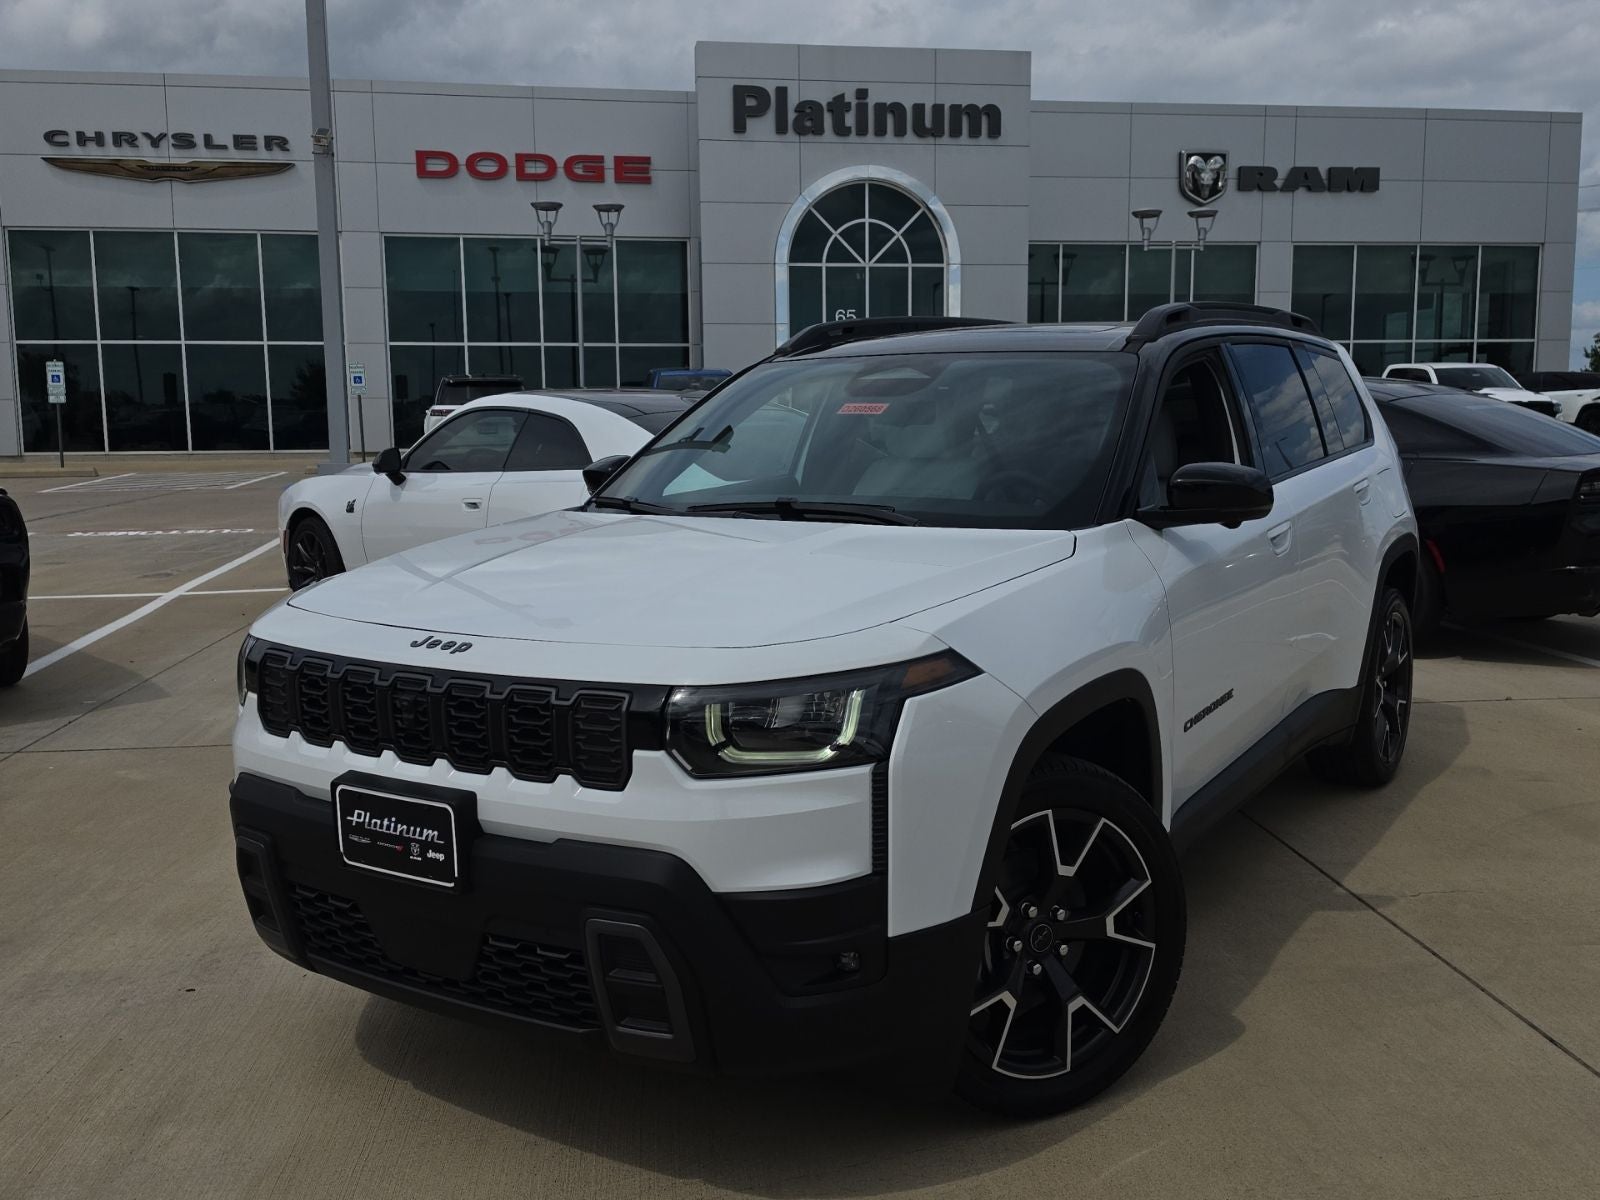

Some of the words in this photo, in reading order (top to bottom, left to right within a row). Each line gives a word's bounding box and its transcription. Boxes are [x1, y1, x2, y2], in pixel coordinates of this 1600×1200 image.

[733, 84, 1002, 138] Platinum
[43, 129, 291, 152] CHRYSLER
[415, 150, 652, 184] DODGE
[1237, 166, 1380, 192] RAM
[410, 635, 473, 654] Jeep
[1183, 687, 1234, 733] CHEROKEE
[346, 809, 445, 844] Platinum
[427, 849, 445, 861] Jeep
